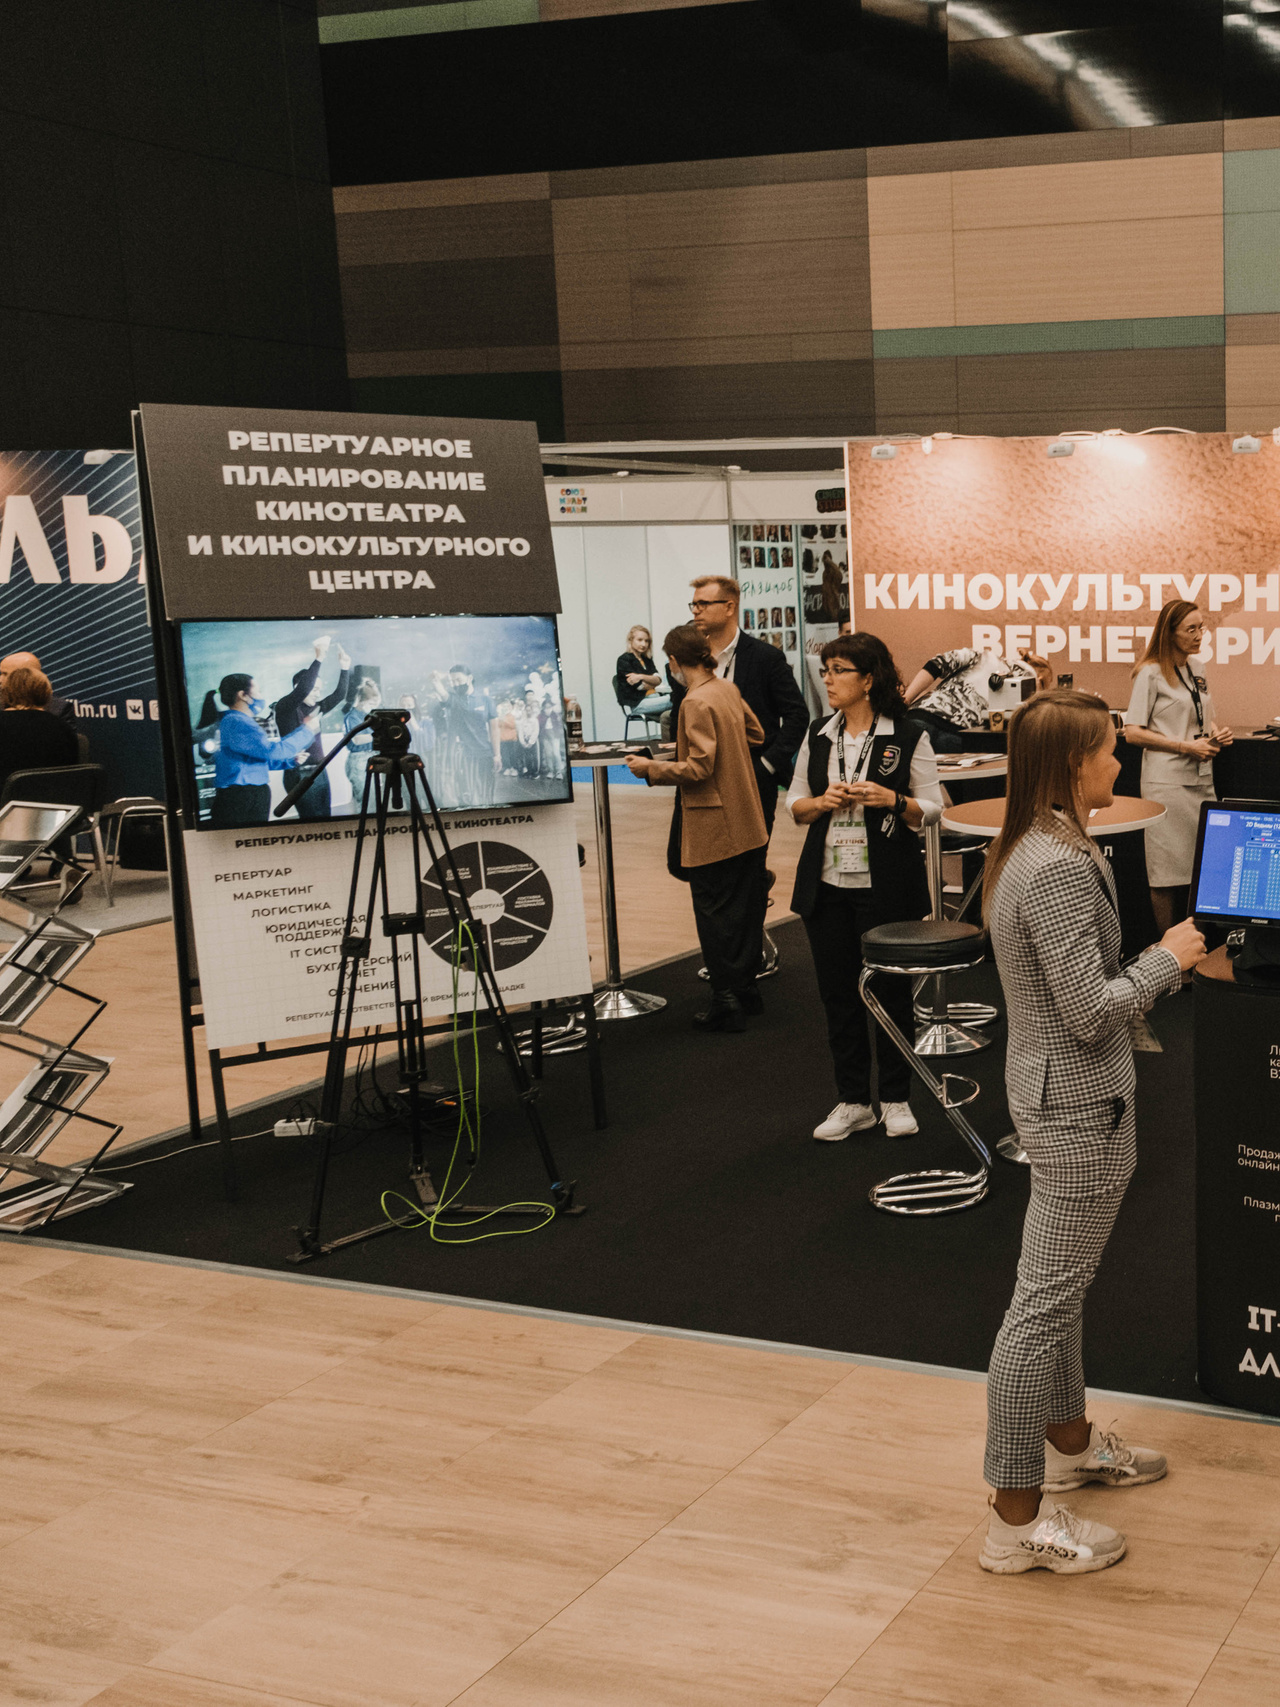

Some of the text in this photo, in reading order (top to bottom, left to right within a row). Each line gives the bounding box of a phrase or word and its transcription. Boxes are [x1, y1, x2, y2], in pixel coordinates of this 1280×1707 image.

[227, 430, 473, 459] РЕПЕРТУАРНОЕ
[221, 464, 487, 492] ПЛАНИРОВАНИЕ
[255, 500, 466, 524] КИНОТЕАТРА
[0, 494, 146, 585] ЛЬ
[187, 533, 531, 558] И КИНОКУЛЬТУРНОГО
[308, 569, 436, 593] ЦЕНТРА
[65, 699, 118, 718] lm.ru
[235, 831, 342, 848] РЕПЕРТУАРНОЕ
[454, 815, 534, 829] КИНОТЕАТРА
[214, 867, 292, 882] РЕПЕРТУАР
[233, 885, 314, 901] МАРКЕТИНГ
[252, 902, 331, 917] ЛОГИСТИКА
[290, 944, 342, 958] IT СИСТ
[1237, 1156, 1280, 1172] онлайн
